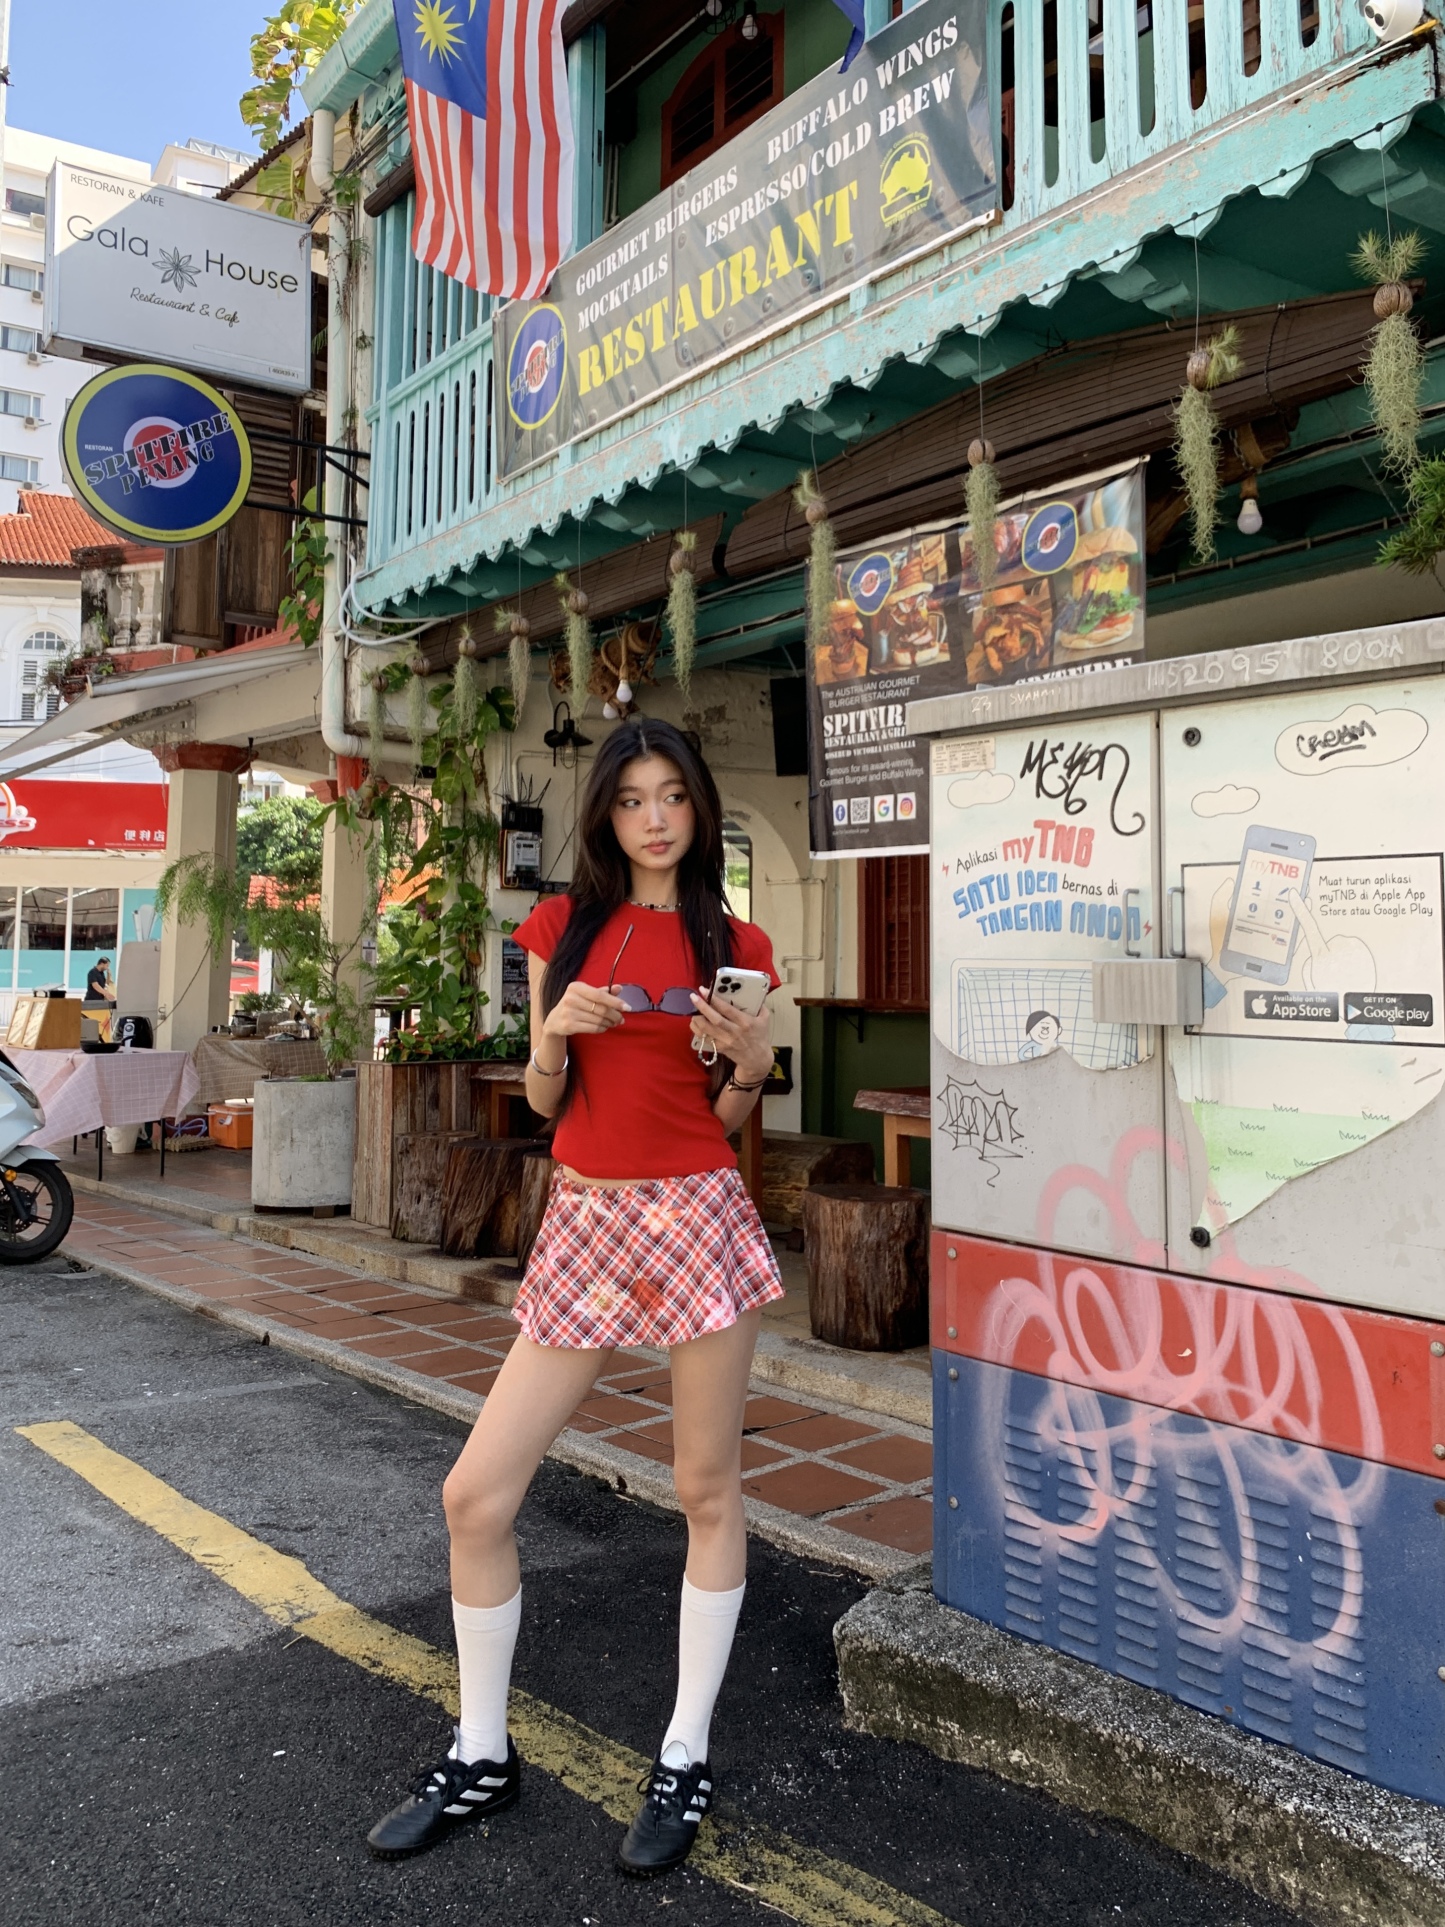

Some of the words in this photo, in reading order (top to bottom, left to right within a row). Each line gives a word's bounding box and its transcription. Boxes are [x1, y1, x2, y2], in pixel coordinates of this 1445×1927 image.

[576, 228, 650, 296] GOURMET
[655, 165, 738, 243] BURGERS
[767, 77, 868, 164] BUFFALO
[876, 15, 958, 89] WINGS
[70, 173, 125, 196] RESTORAN
[128, 188, 137, 199] &
[140, 192, 165, 207] KAFE
[578, 253, 669, 332] MOCKTAILS
[878, 68, 956, 136] BREW
[67, 215, 149, 257] Gala
[206, 249, 298, 293] House
[578, 180, 858, 396] RESTAURANT
[130, 287, 195, 313] Restaurant
[199, 304, 210, 317] &
[215, 307, 240, 328] Cafe
[84, 412, 233, 487] SPITFIRE
[85, 444, 113, 452] RESTORAN
[120, 441, 215, 495] PENANG
[821, 690, 834, 699] The
[878, 675, 920, 689] GOURMET
[829, 695, 861, 708] BURGER
[823, 704, 906, 738] SPITFIR
[824, 730, 880, 748] RESTAURANT
[853, 745, 882, 756] VICTORIA
[826, 765, 849, 776] Famous
[851, 764, 860, 773] for
[845, 774, 867, 785] Burger
[869, 772, 881, 781] and
[882, 769, 904, 780] Buffalo
[905, 767, 924, 777] Wings
[124, 829, 166, 842] 便利店
[956, 848, 998, 874] Aplikasi
[1002, 819, 1095, 868] myTNB
[1319, 875, 1342, 886] Muat
[1346, 876, 1371, 885] turun
[1374, 873, 1412, 887] aplikasi
[953, 873, 1010, 919] SATU
[1017, 869, 1058, 897] IDEA
[1062, 873, 1103, 896] bernas
[1107, 879, 1118, 896] di
[1319, 889, 1357, 903] myTNB
[1360, 889, 1369, 900] di
[1372, 888, 1401, 903] Apple
[1404, 888, 1426, 902] App
[976, 900, 1062, 937] TANGAN
[1070, 901, 1141, 942] ANDA
[1319, 904, 1347, 916] Store
[1350, 906, 1370, 916] atau
[1373, 903, 1407, 918] Google
[1410, 902, 1433, 917] Play
[1272, 1003, 1297, 1018] App
[1298, 1004, 1331, 1017] Store
[1363, 1006, 1405, 1022] Google
[1406, 1008, 1430, 1022] play
